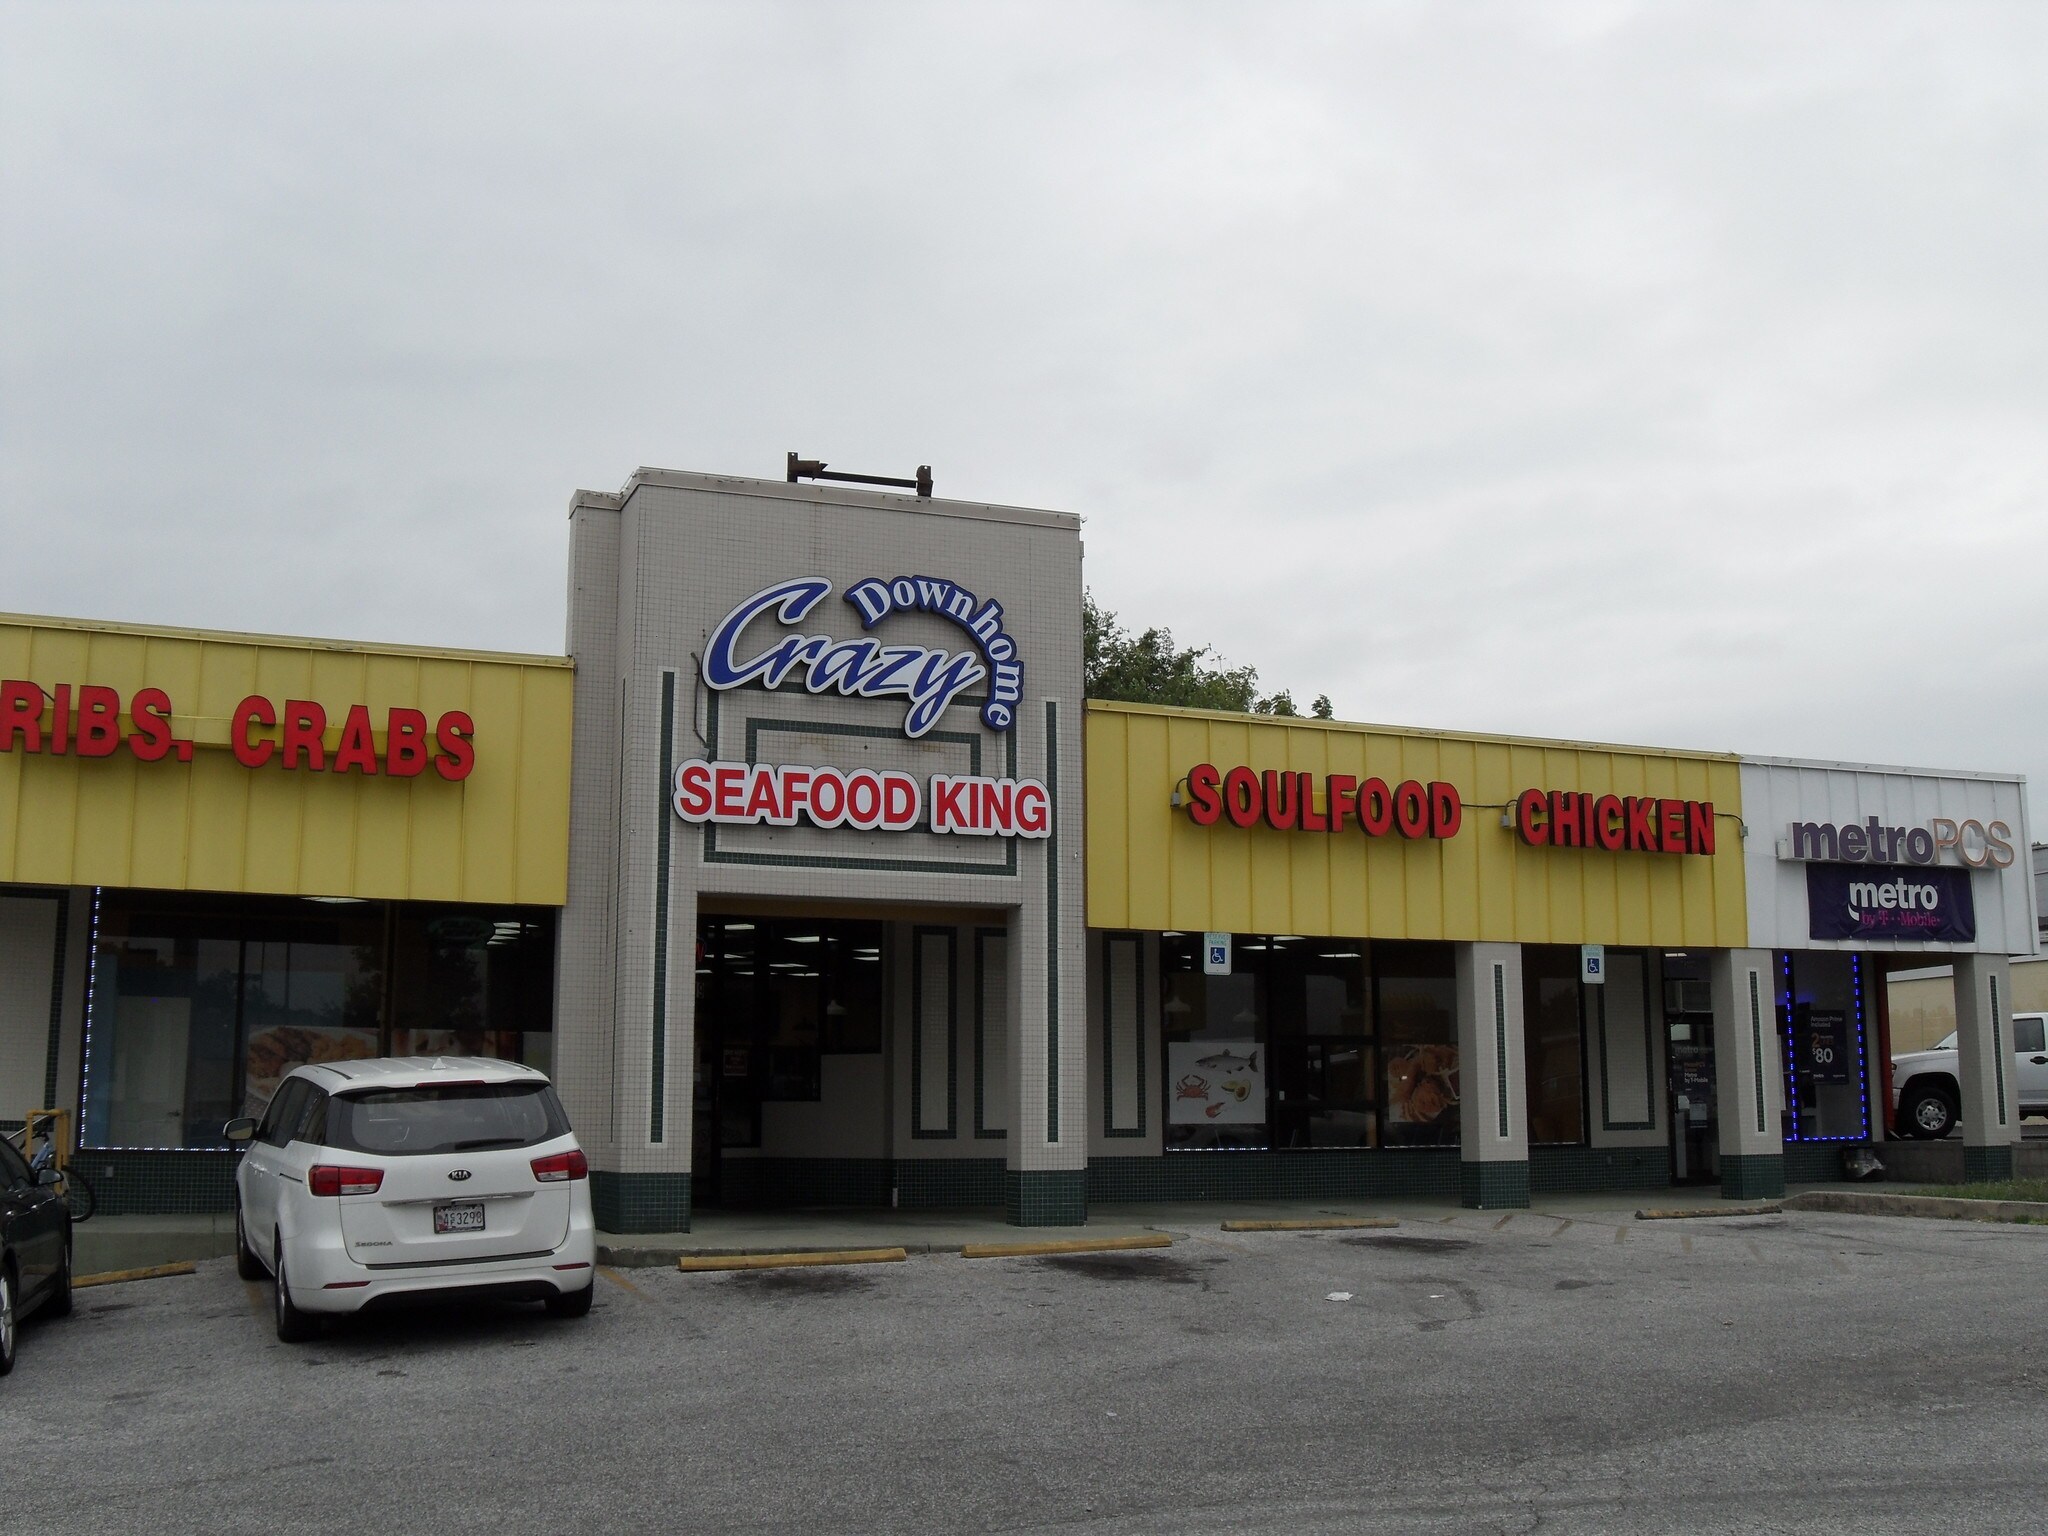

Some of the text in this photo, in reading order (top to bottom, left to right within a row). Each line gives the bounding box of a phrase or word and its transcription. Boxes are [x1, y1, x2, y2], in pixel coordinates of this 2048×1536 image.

[704, 578, 985, 735] Crazy
[849, 579, 1023, 729] Downhome
[231, 695, 475, 781] CRABS
[680, 765, 1047, 832] SEAFOOD KING
[1188, 763, 1716, 855] SOULFOOD CHICKEN
[1792, 815, 2016, 869] metroPCS
[1848, 878, 1939, 921] metro
[1861, 911, 1875, 928] by
[1811, 1047, 1834, 1064] $80
[451, 1169, 469, 1179] KIA
